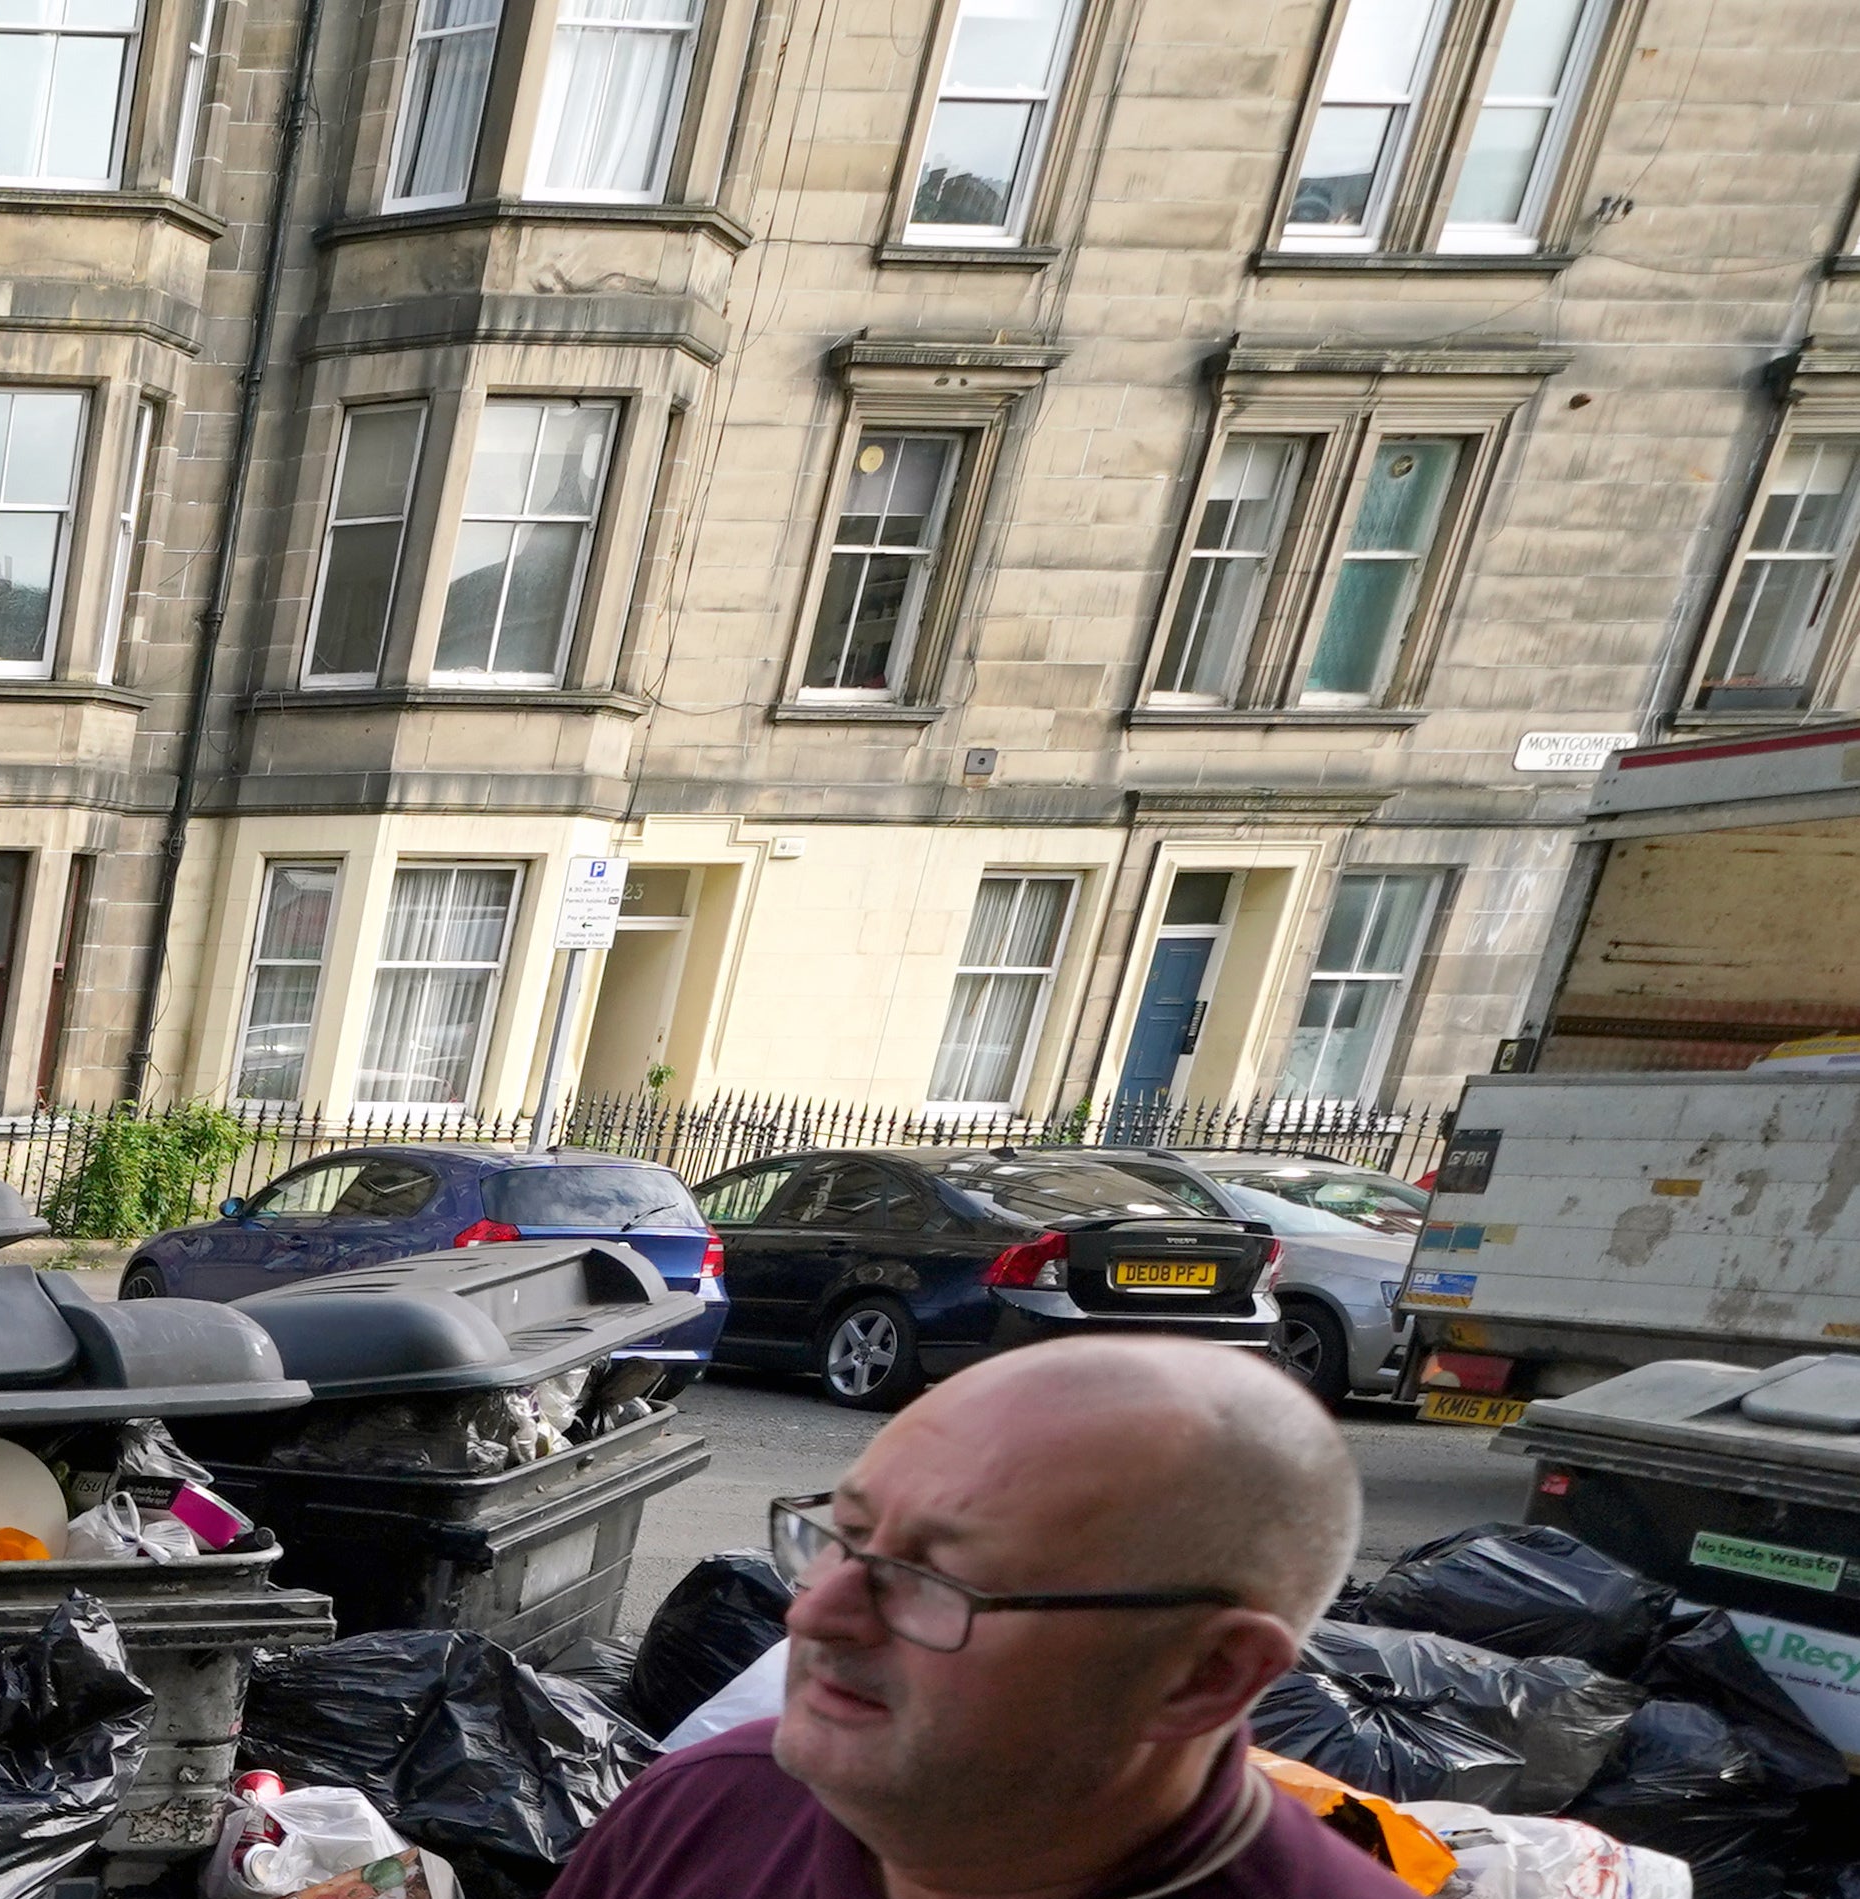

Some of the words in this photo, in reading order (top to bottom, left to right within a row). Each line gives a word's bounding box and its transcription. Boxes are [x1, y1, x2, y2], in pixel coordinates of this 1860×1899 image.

[1525, 737, 1633, 751] MONTGOMERY
[1545, 753, 1602, 766] STREET
[623, 884, 644, 900] 23
[1126, 1265, 1171, 1281] DE08
[1175, 1266, 1209, 1282] PFJ
[1433, 1397, 1480, 1417] KM16
[1483, 1401, 1524, 1422] MY
[1696, 1540, 1716, 1553] No
[1719, 1543, 1765, 1561] trade
